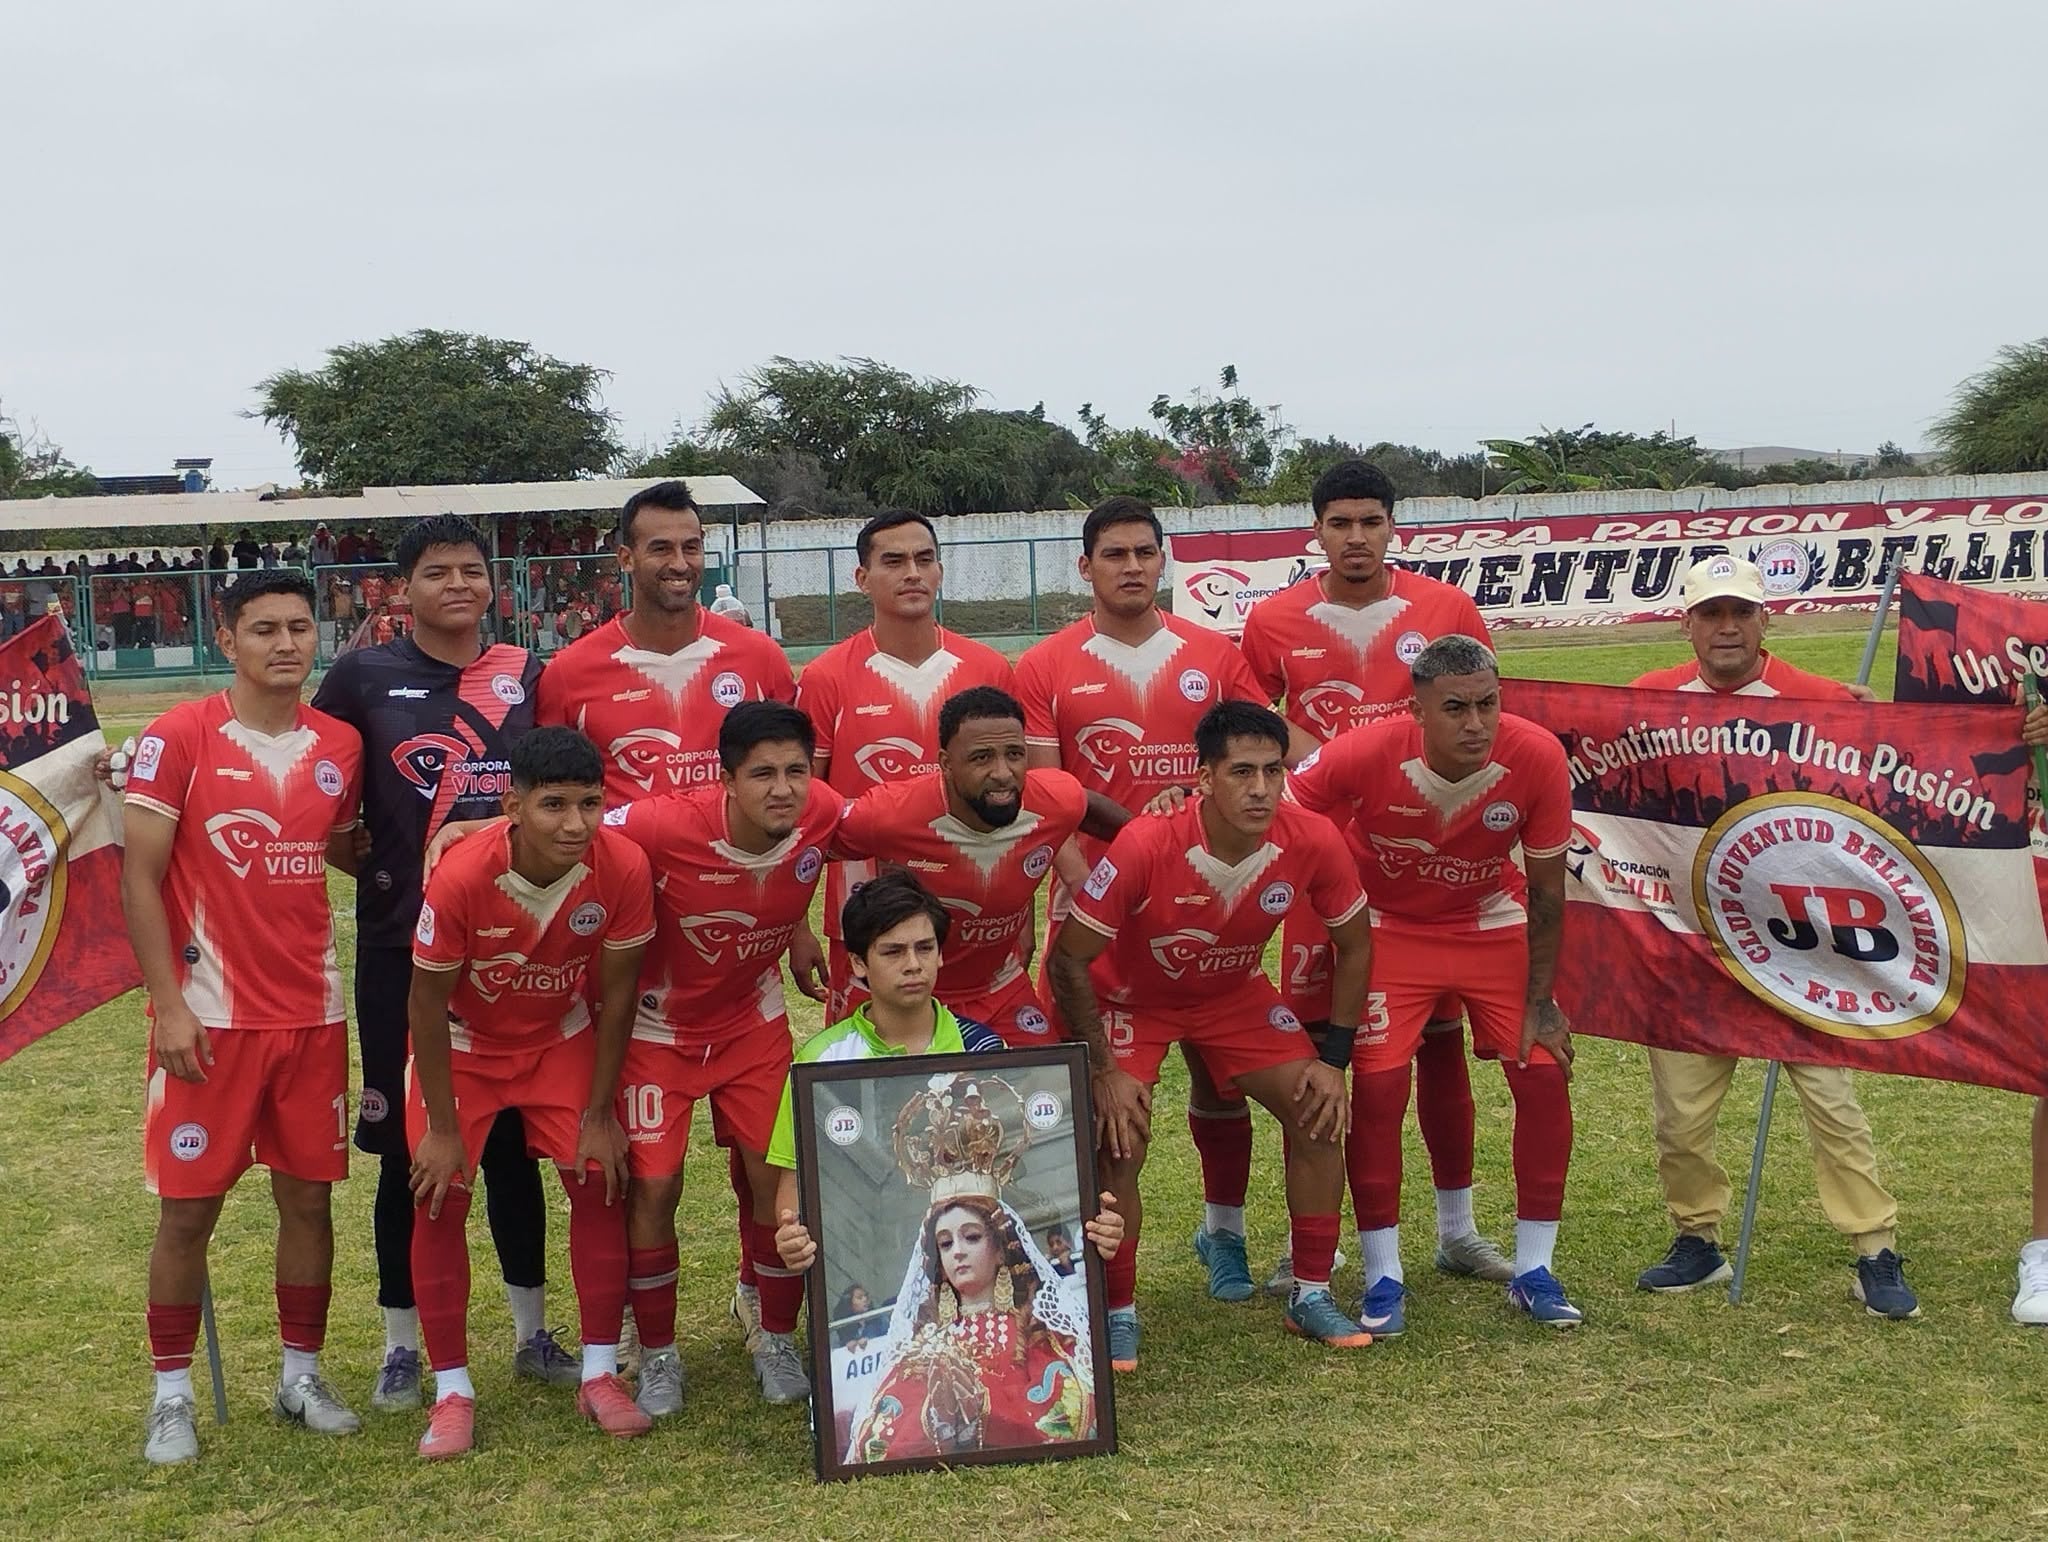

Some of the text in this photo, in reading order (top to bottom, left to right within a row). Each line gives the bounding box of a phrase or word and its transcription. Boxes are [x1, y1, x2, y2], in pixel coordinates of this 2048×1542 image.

[1591, 512, 1850, 542] PASION
[1884, 505, 1937, 529] Y
[1767, 559, 1796, 577] JB
[1828, 529, 2048, 590] BELLA
[1953, 648, 2010, 694] Un
[322, 770, 338, 785] JB
[1581, 715, 1780, 777] Sentimiento,
[1788, 722, 1861, 777] Una
[1868, 743, 1996, 831] Pasión
[1490, 811, 1510, 823] JB
[1268, 892, 1286, 905] JB
[1717, 817, 1941, 987] CLUB JUVENTUD BELLAVISTA
[1767, 883, 1900, 963] JB
[1026, 1014, 1044, 1026] JB
[623, 1083, 664, 1130] 10
[1033, 1103, 1055, 1117] JB
[834, 1119, 855, 1132] JB
[178, 1135, 200, 1148] JB
